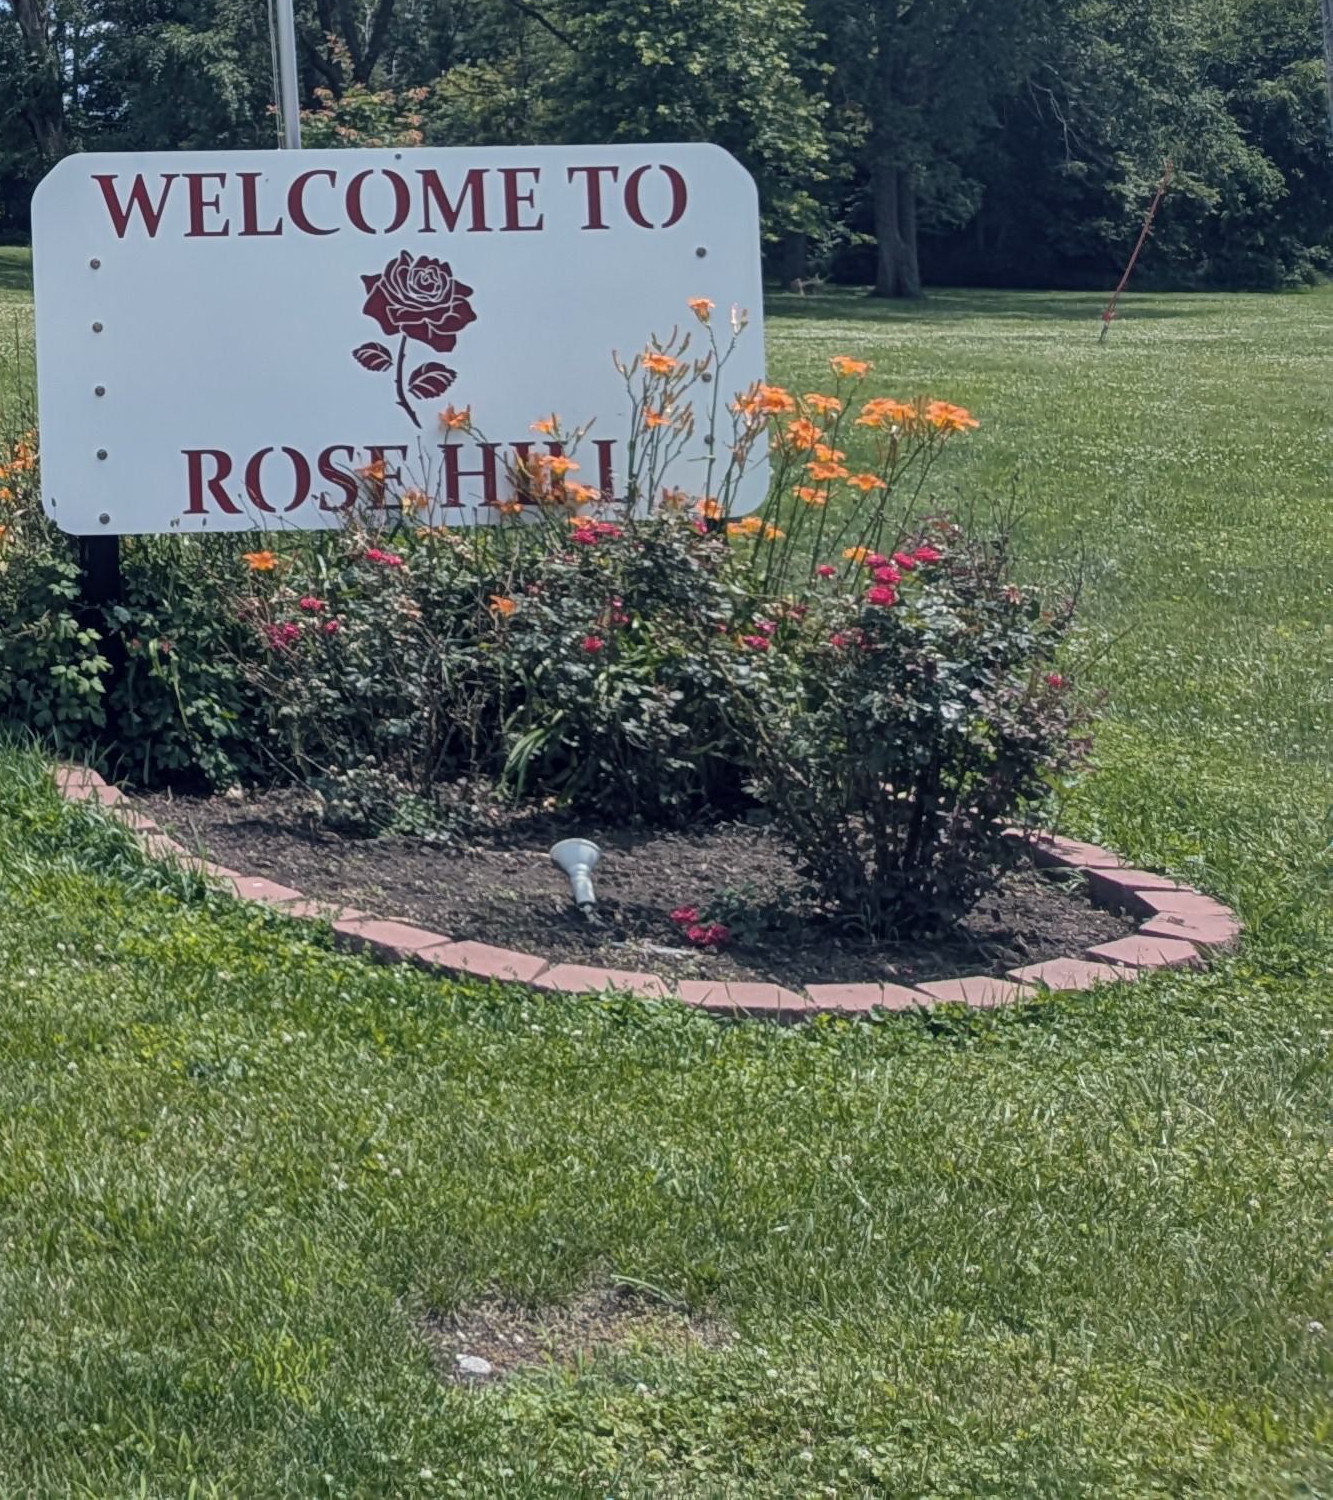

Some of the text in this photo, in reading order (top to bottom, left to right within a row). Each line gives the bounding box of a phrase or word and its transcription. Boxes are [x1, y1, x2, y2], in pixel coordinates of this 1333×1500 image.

[91, 164, 688, 238] WELCOME TO
[181, 444, 408, 515] ROSE
